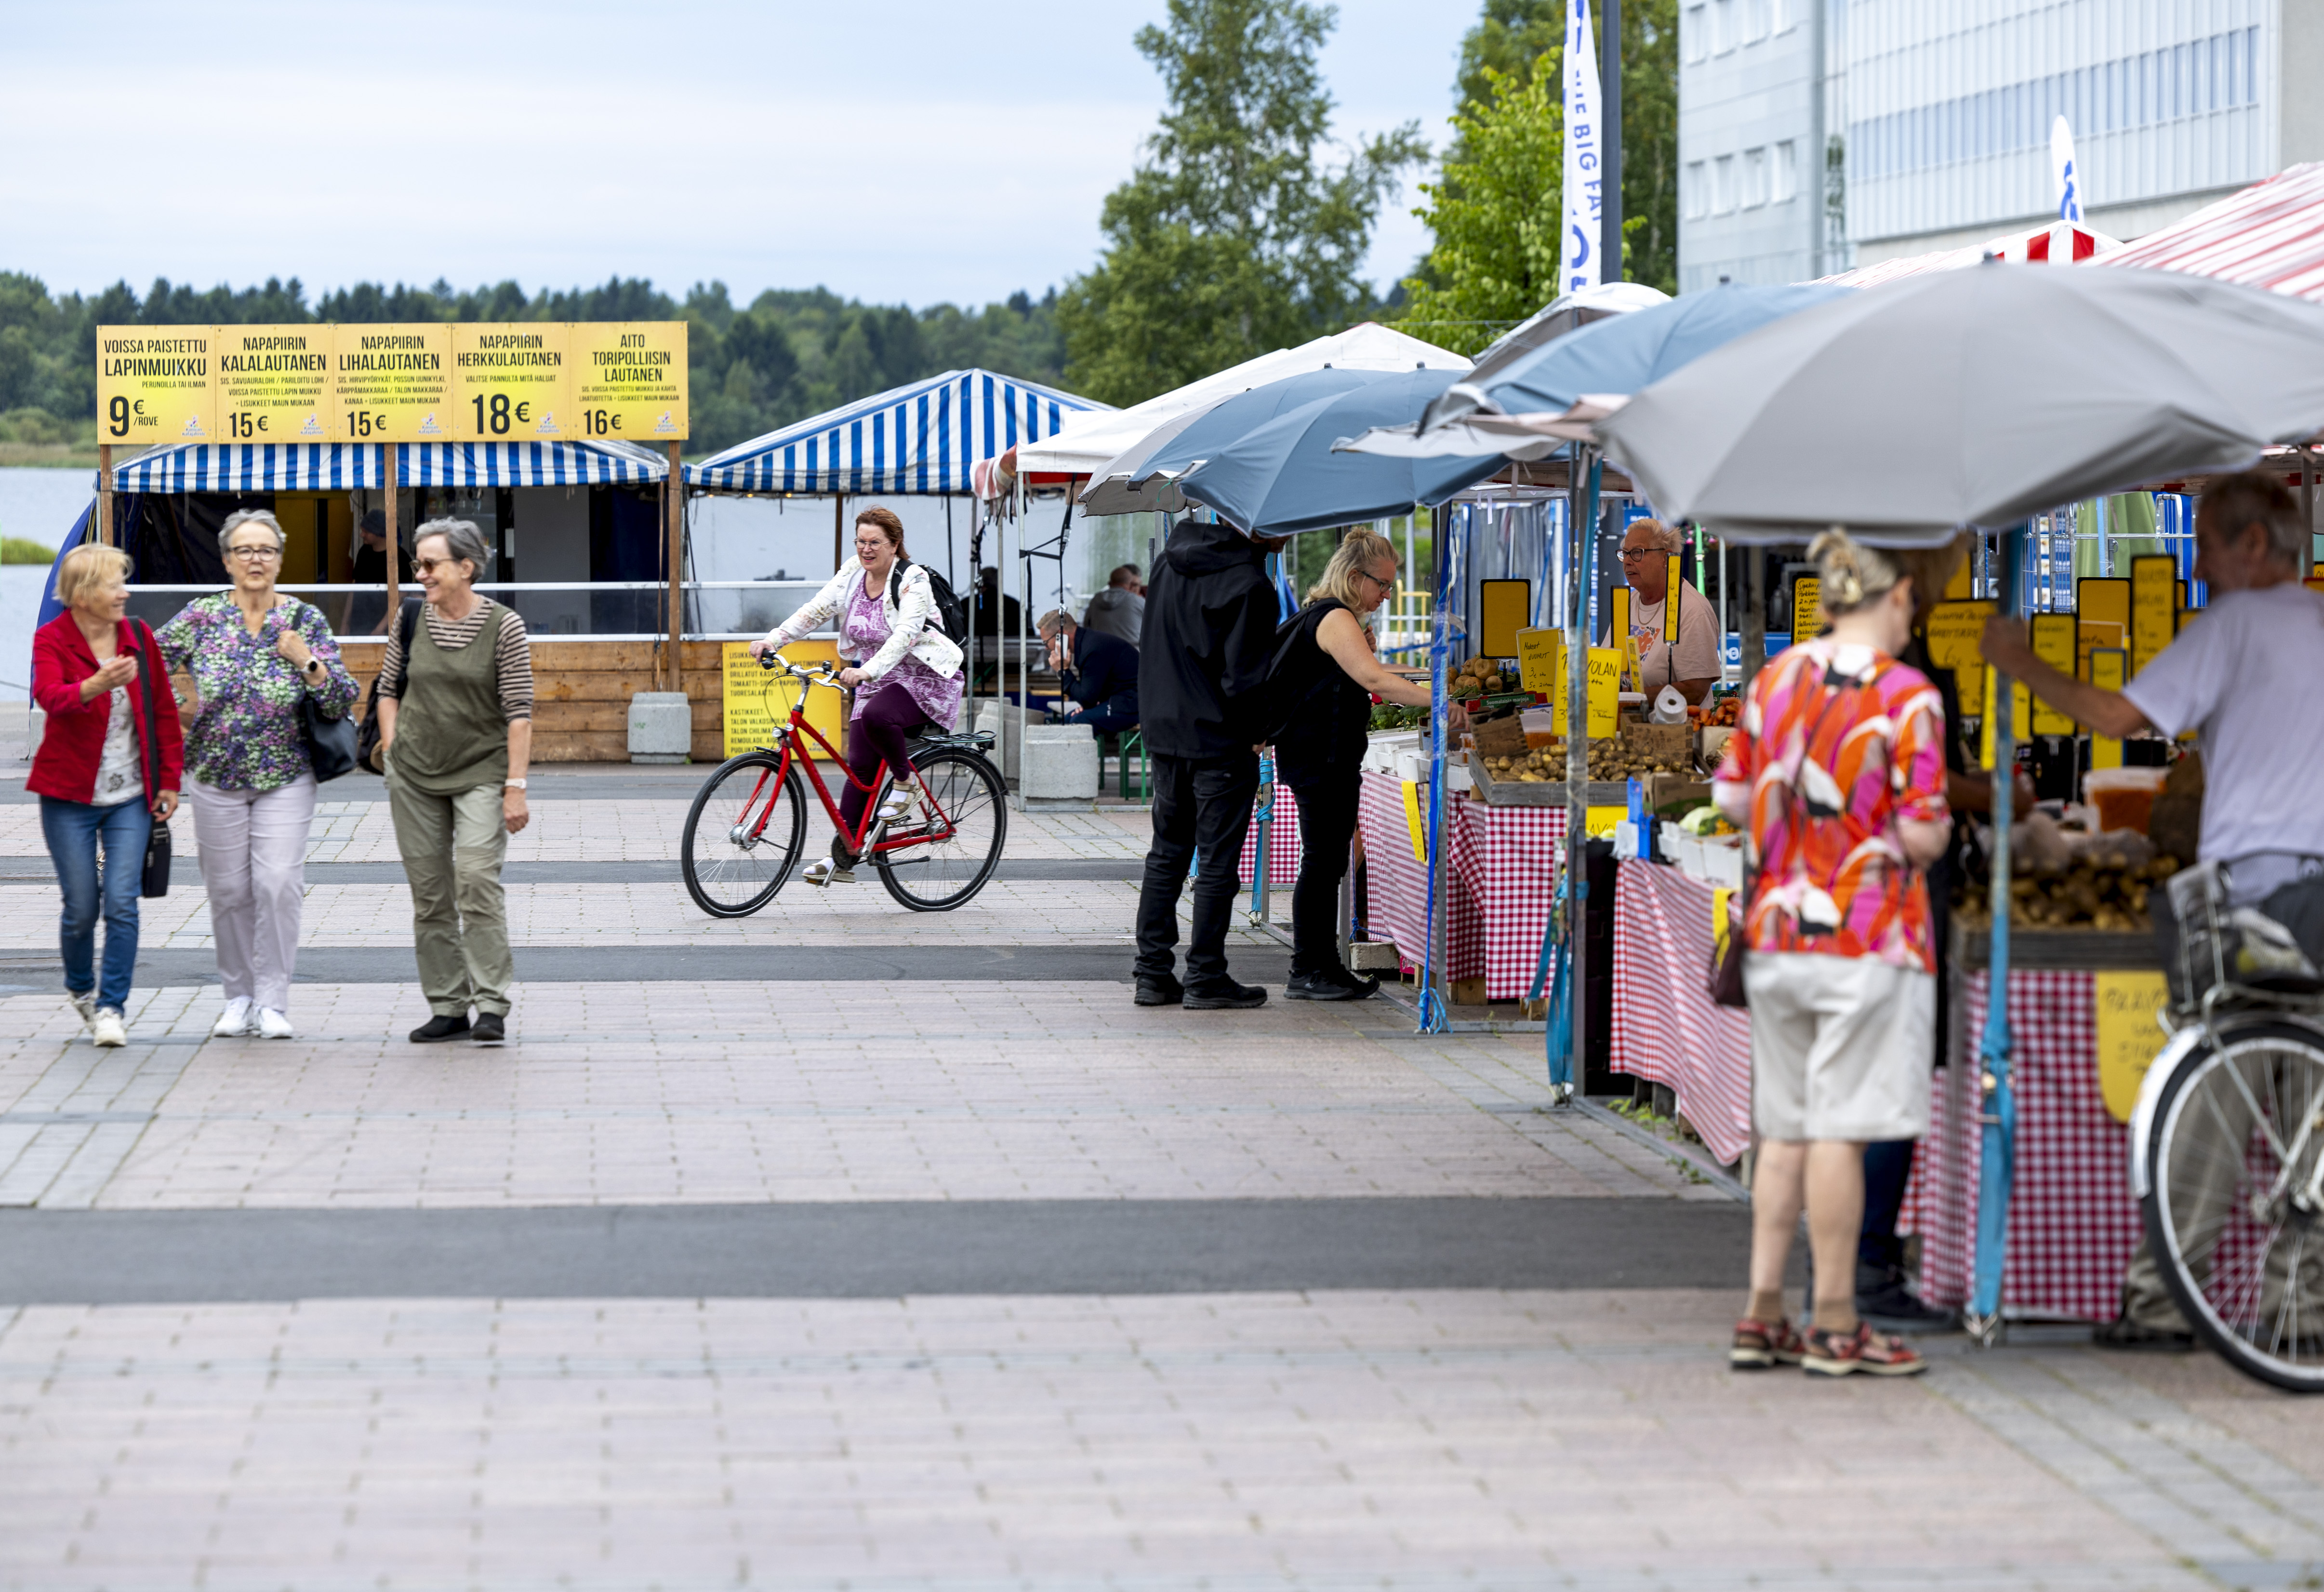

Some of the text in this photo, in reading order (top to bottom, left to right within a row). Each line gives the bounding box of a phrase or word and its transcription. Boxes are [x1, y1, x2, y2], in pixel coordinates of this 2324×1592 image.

[1574, 124, 1597, 171] BIG
[104, 339, 206, 353] VOISSA PAISTETTU
[243, 336, 306, 350] NAPAPIIRIN
[361, 335, 424, 349] NAPAPIIRIN
[480, 335, 543, 349] NAPAPIIRIN
[620, 334, 645, 348] AITO
[221, 354, 326, 372] KALALAUTANEN
[340, 353, 439, 371] LIHALAUTANEN
[458, 352, 561, 366] HERKKULAUTANEN
[592, 351, 670, 365] TORIPOLLIISIN
[105, 358, 206, 376] LAPINMUIKKU
[490, 375, 518, 383] PANNULTA
[605, 368, 662, 382] LAUTANEN
